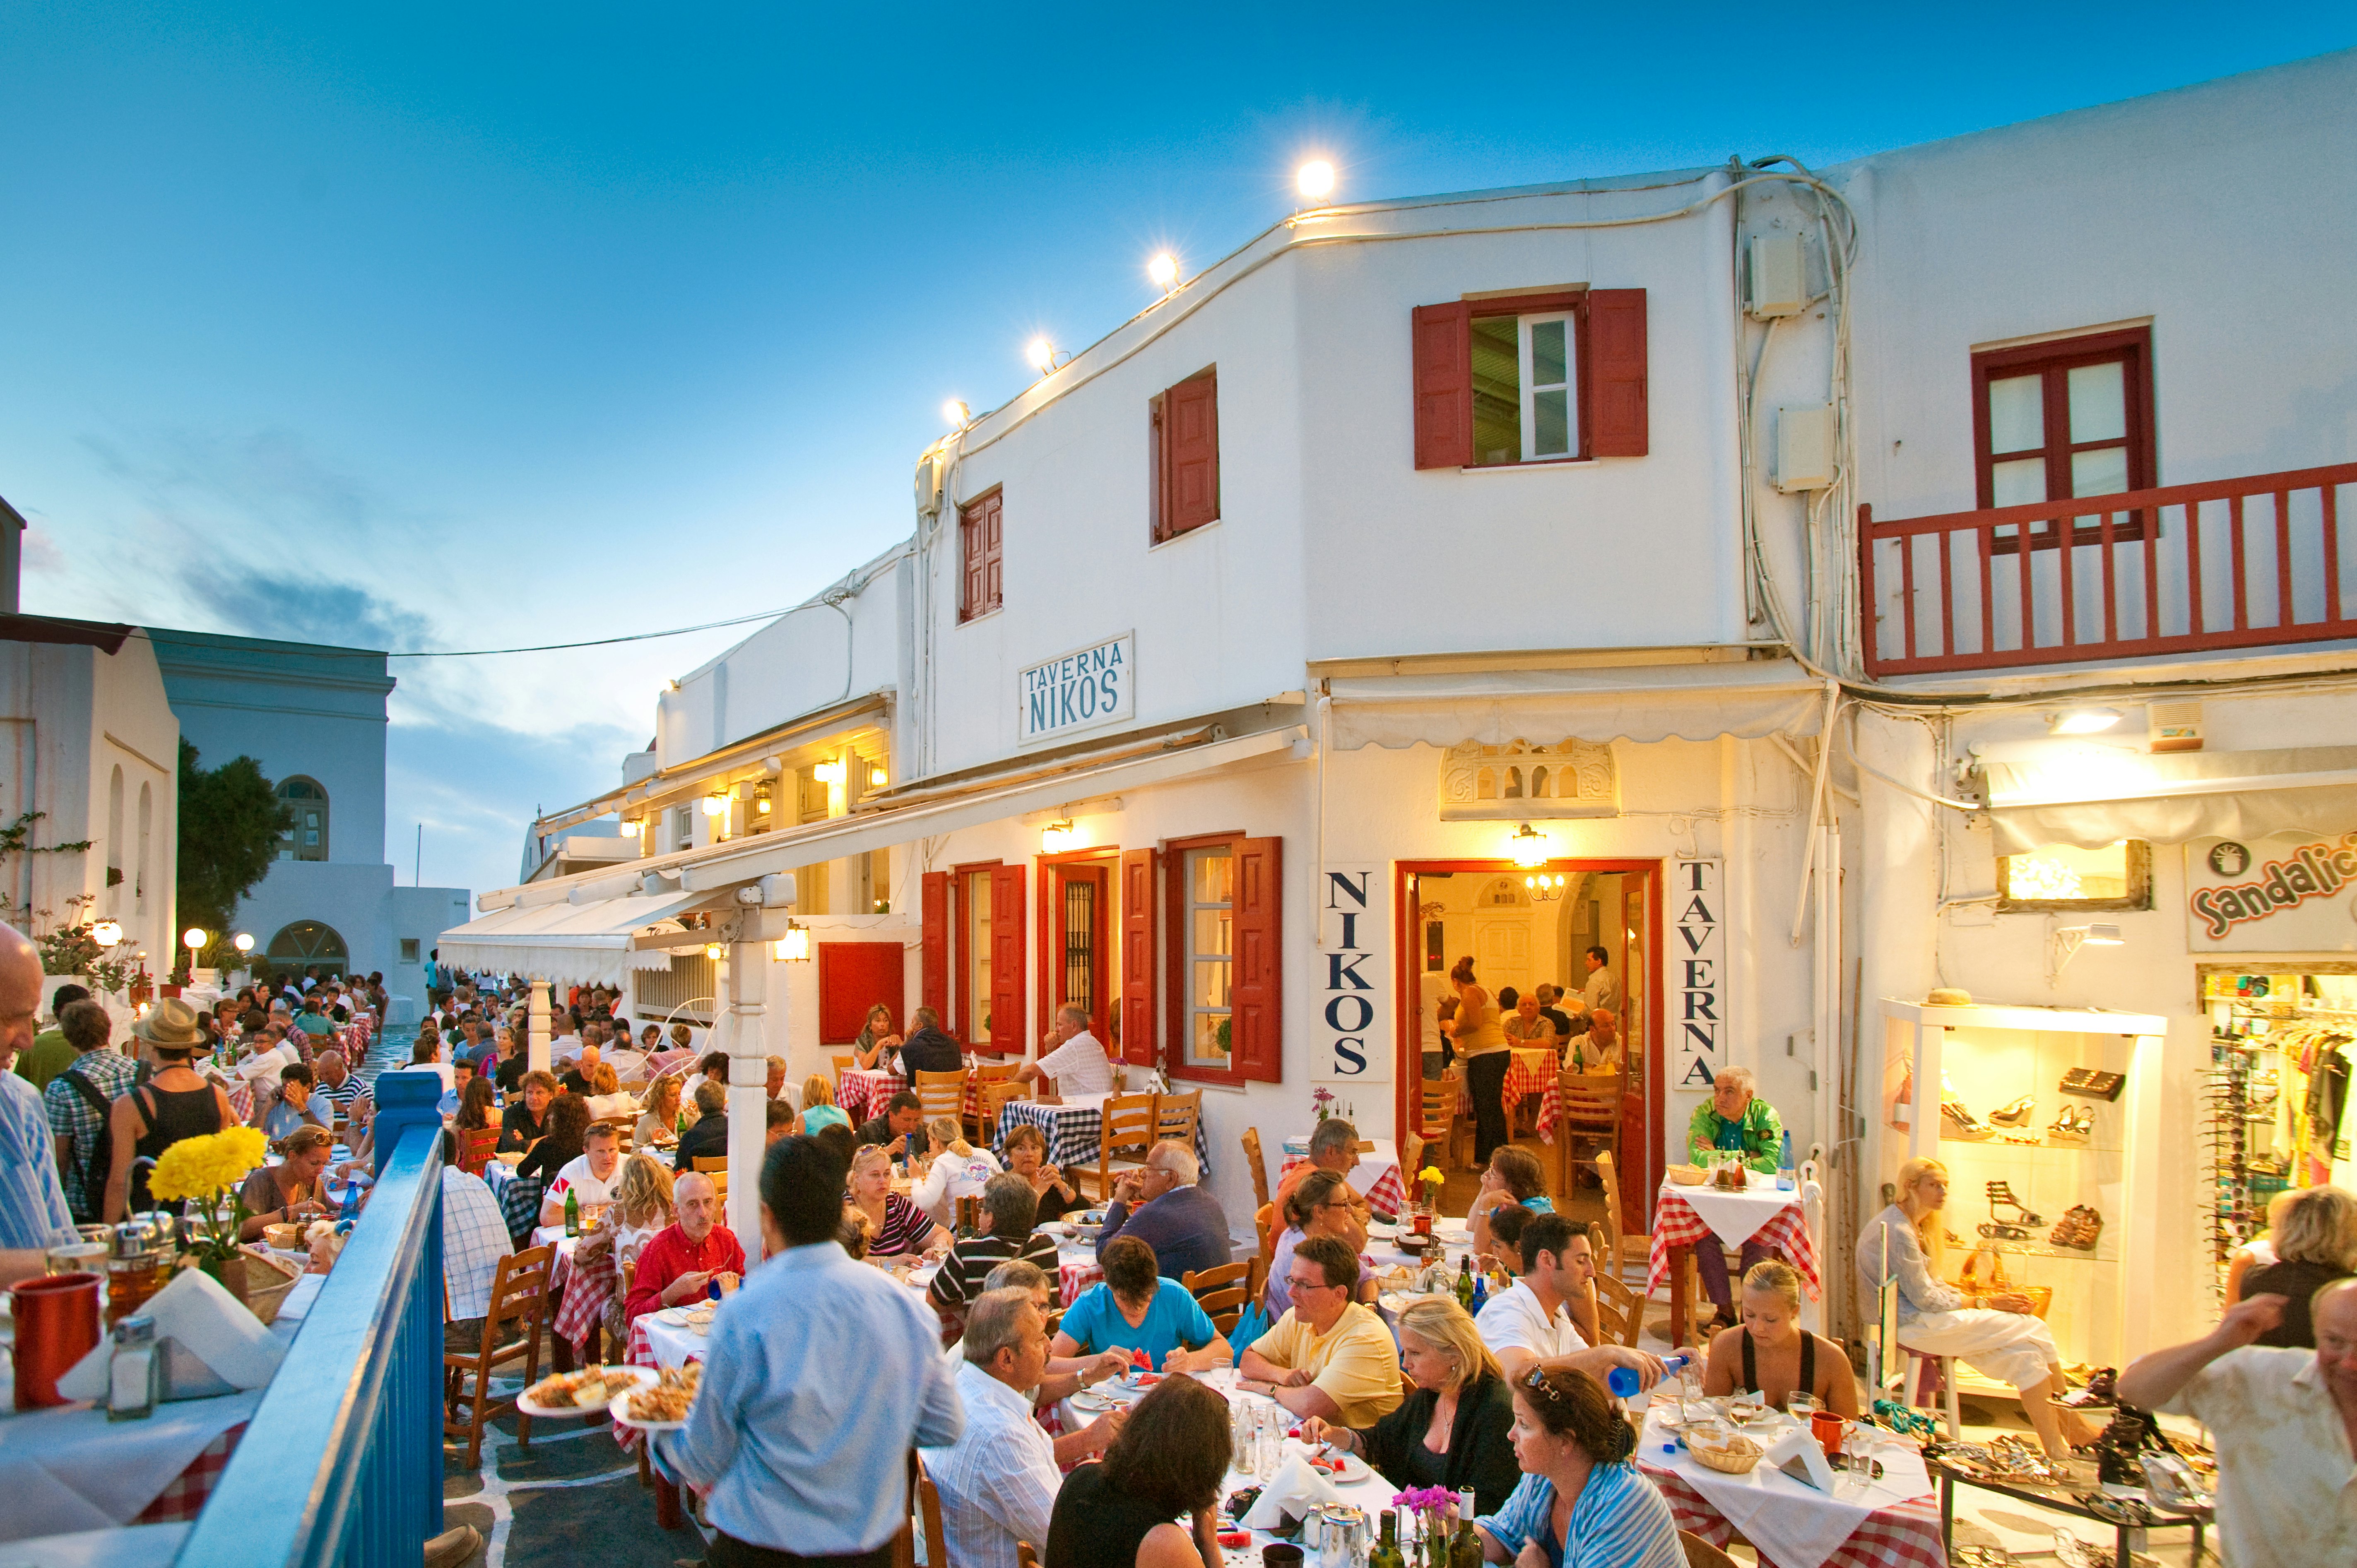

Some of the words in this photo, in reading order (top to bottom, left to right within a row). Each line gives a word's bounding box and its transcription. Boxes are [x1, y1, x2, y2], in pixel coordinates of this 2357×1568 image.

[1026, 643, 1123, 691] TAVERNA
[1030, 669, 1117, 734] NIKOS
[1325, 872, 1375, 1075] NIKOS
[1677, 862, 1721, 1085] TAVERNA
